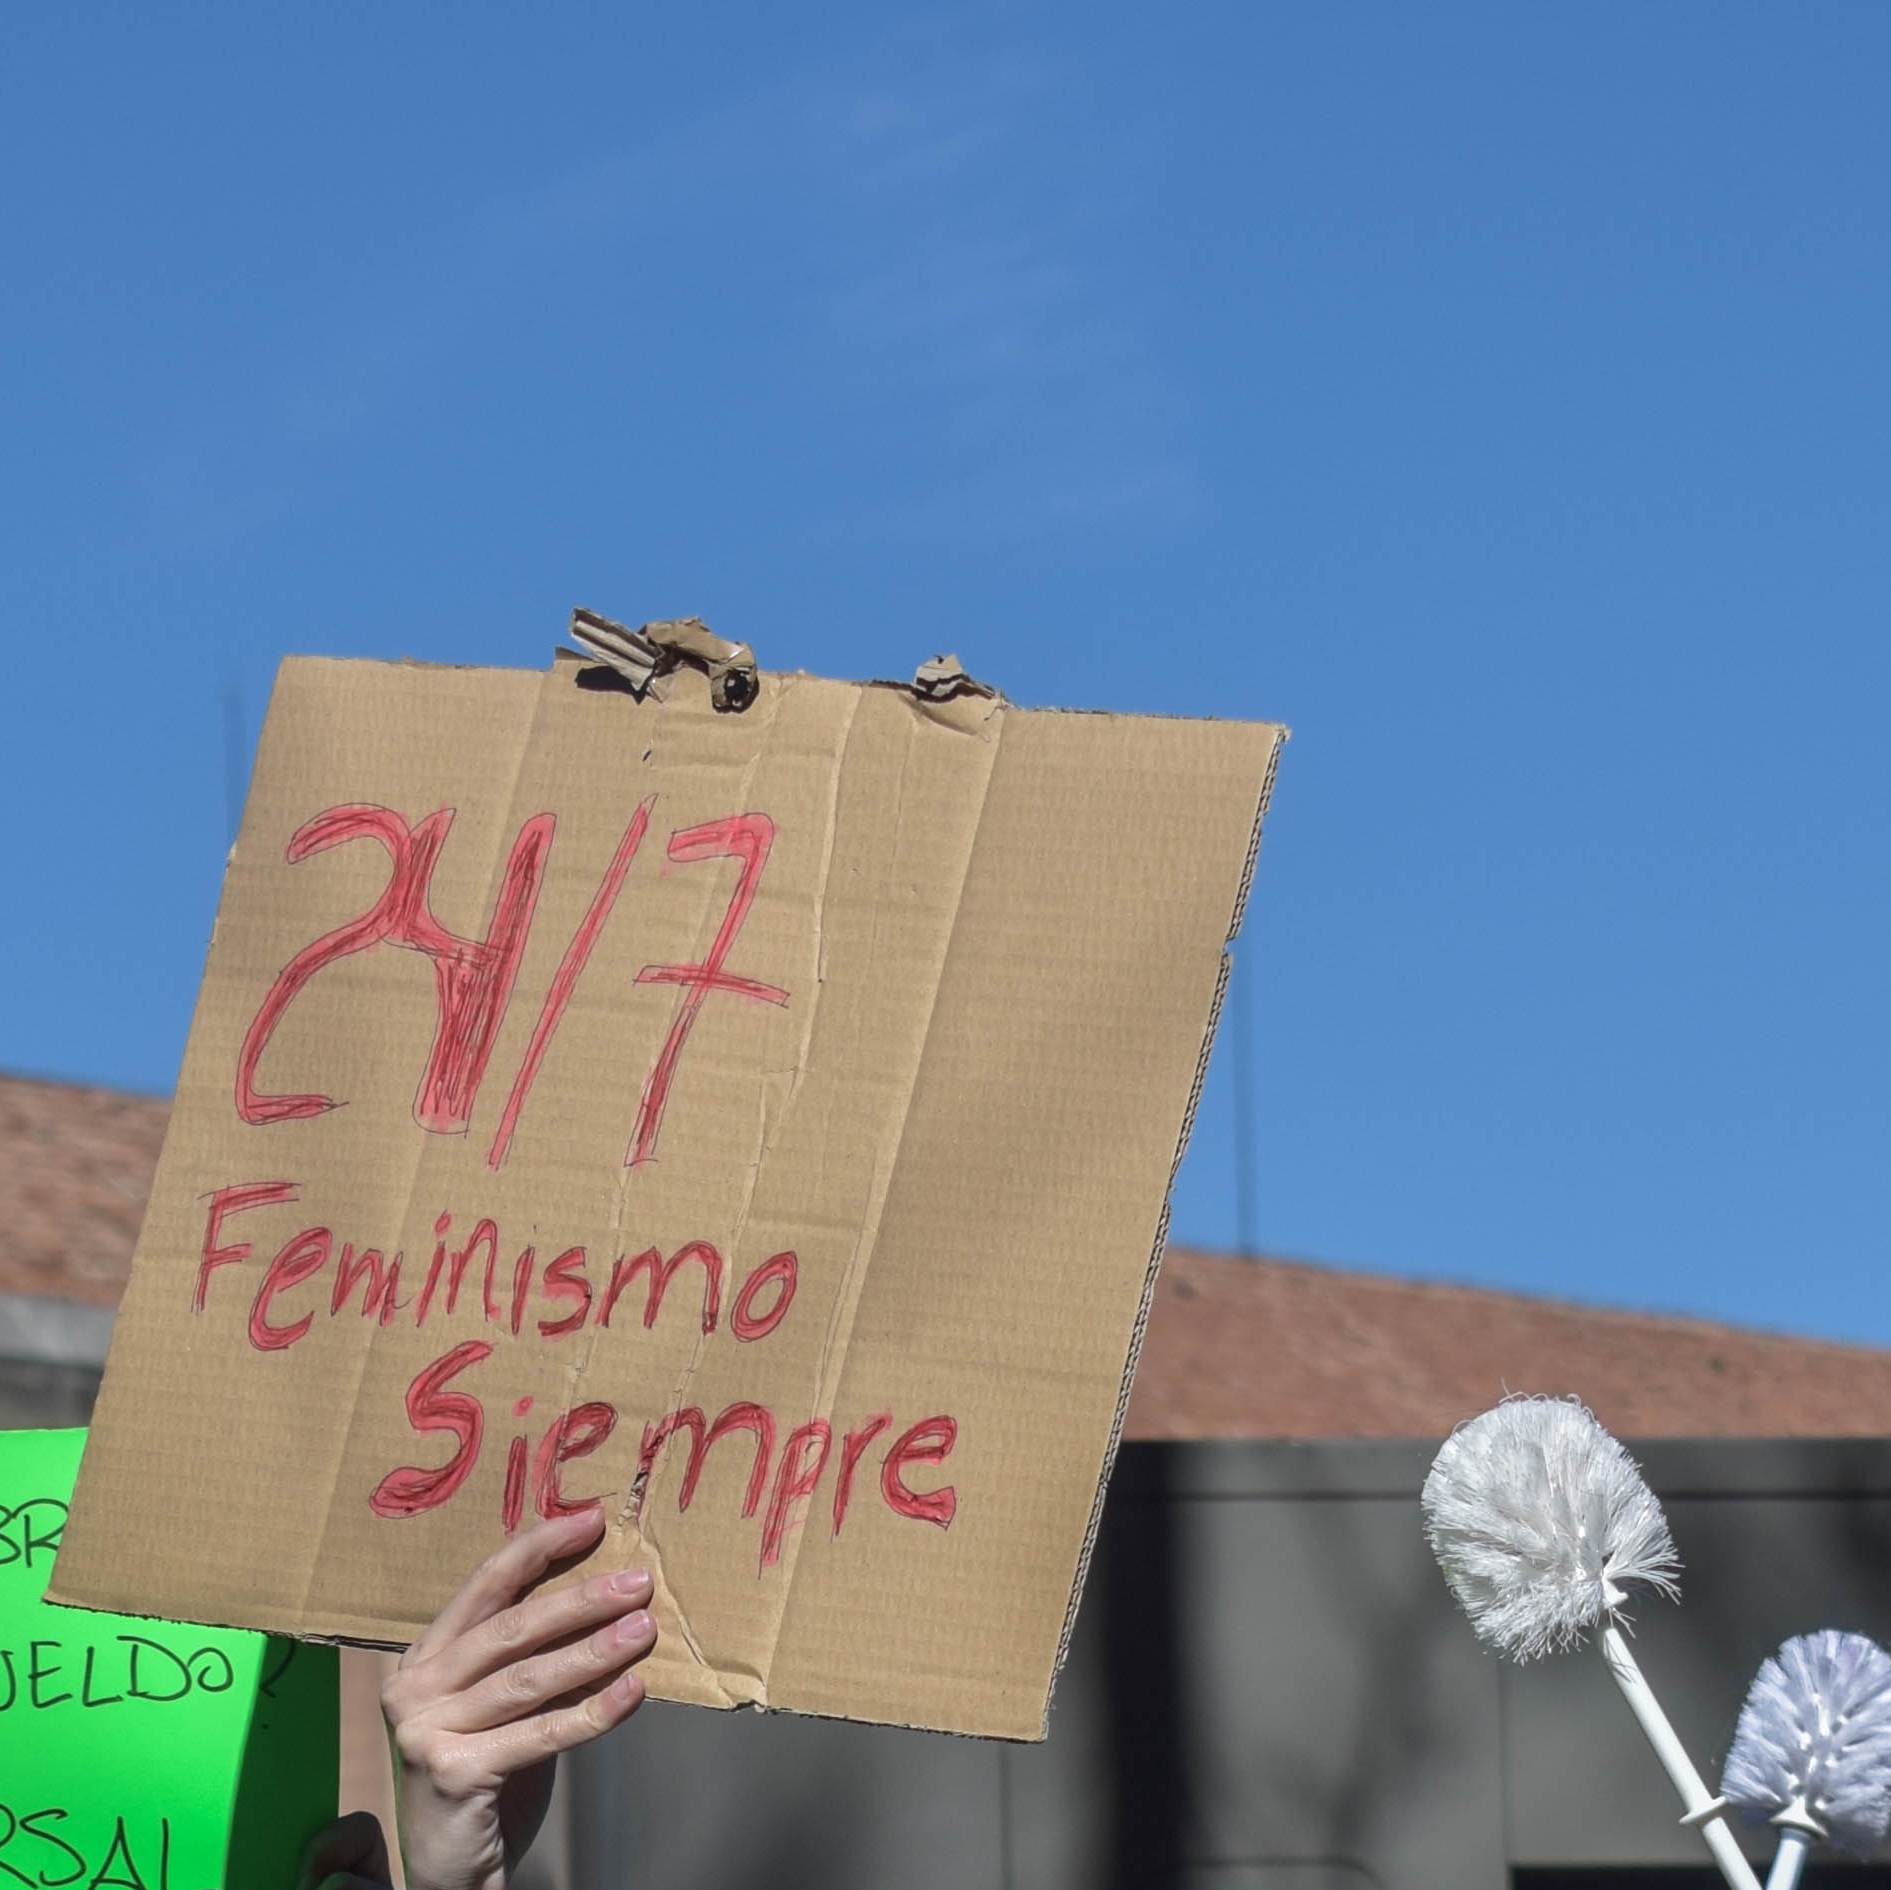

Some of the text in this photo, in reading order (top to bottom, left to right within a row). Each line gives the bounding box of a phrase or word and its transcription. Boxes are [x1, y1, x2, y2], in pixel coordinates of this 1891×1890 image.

[235, 794, 791, 1169] 24/7
[191, 1183, 799, 1352] Feminismo
[368, 1342, 957, 1579] Siempre
